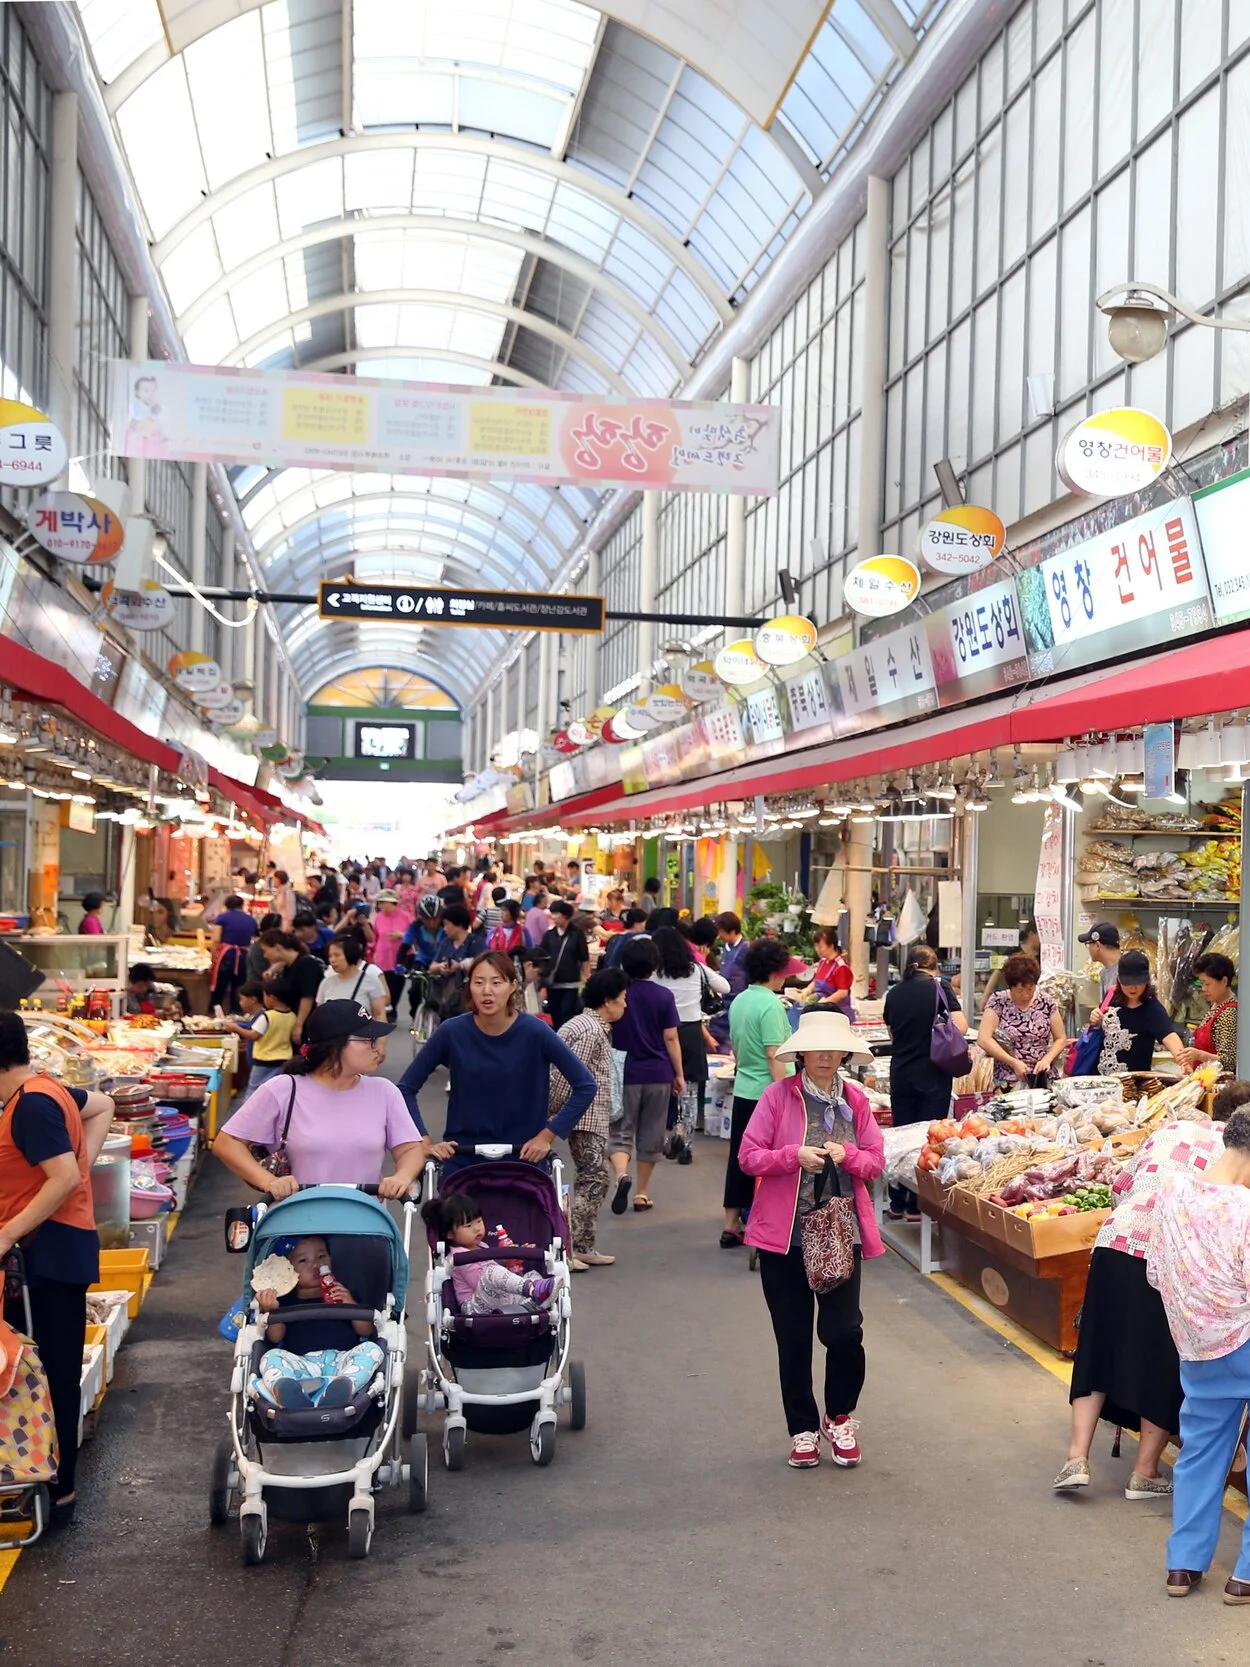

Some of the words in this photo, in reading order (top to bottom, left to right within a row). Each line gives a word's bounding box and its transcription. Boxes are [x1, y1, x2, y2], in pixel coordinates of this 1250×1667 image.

[0, 433, 53, 452] 그릇
[1078, 439, 1163, 464] 영창건어물
[35, 509, 112, 534] 게박사
[928, 529, 996, 548] 강원도상회
[935, 552, 981, 565] 342-5042
[1051, 559, 1094, 629] 영창
[1110, 516, 1194, 605] 건어물
[852, 576, 913, 594] 제일수산
[951, 594, 1021, 663] 강원도상회
